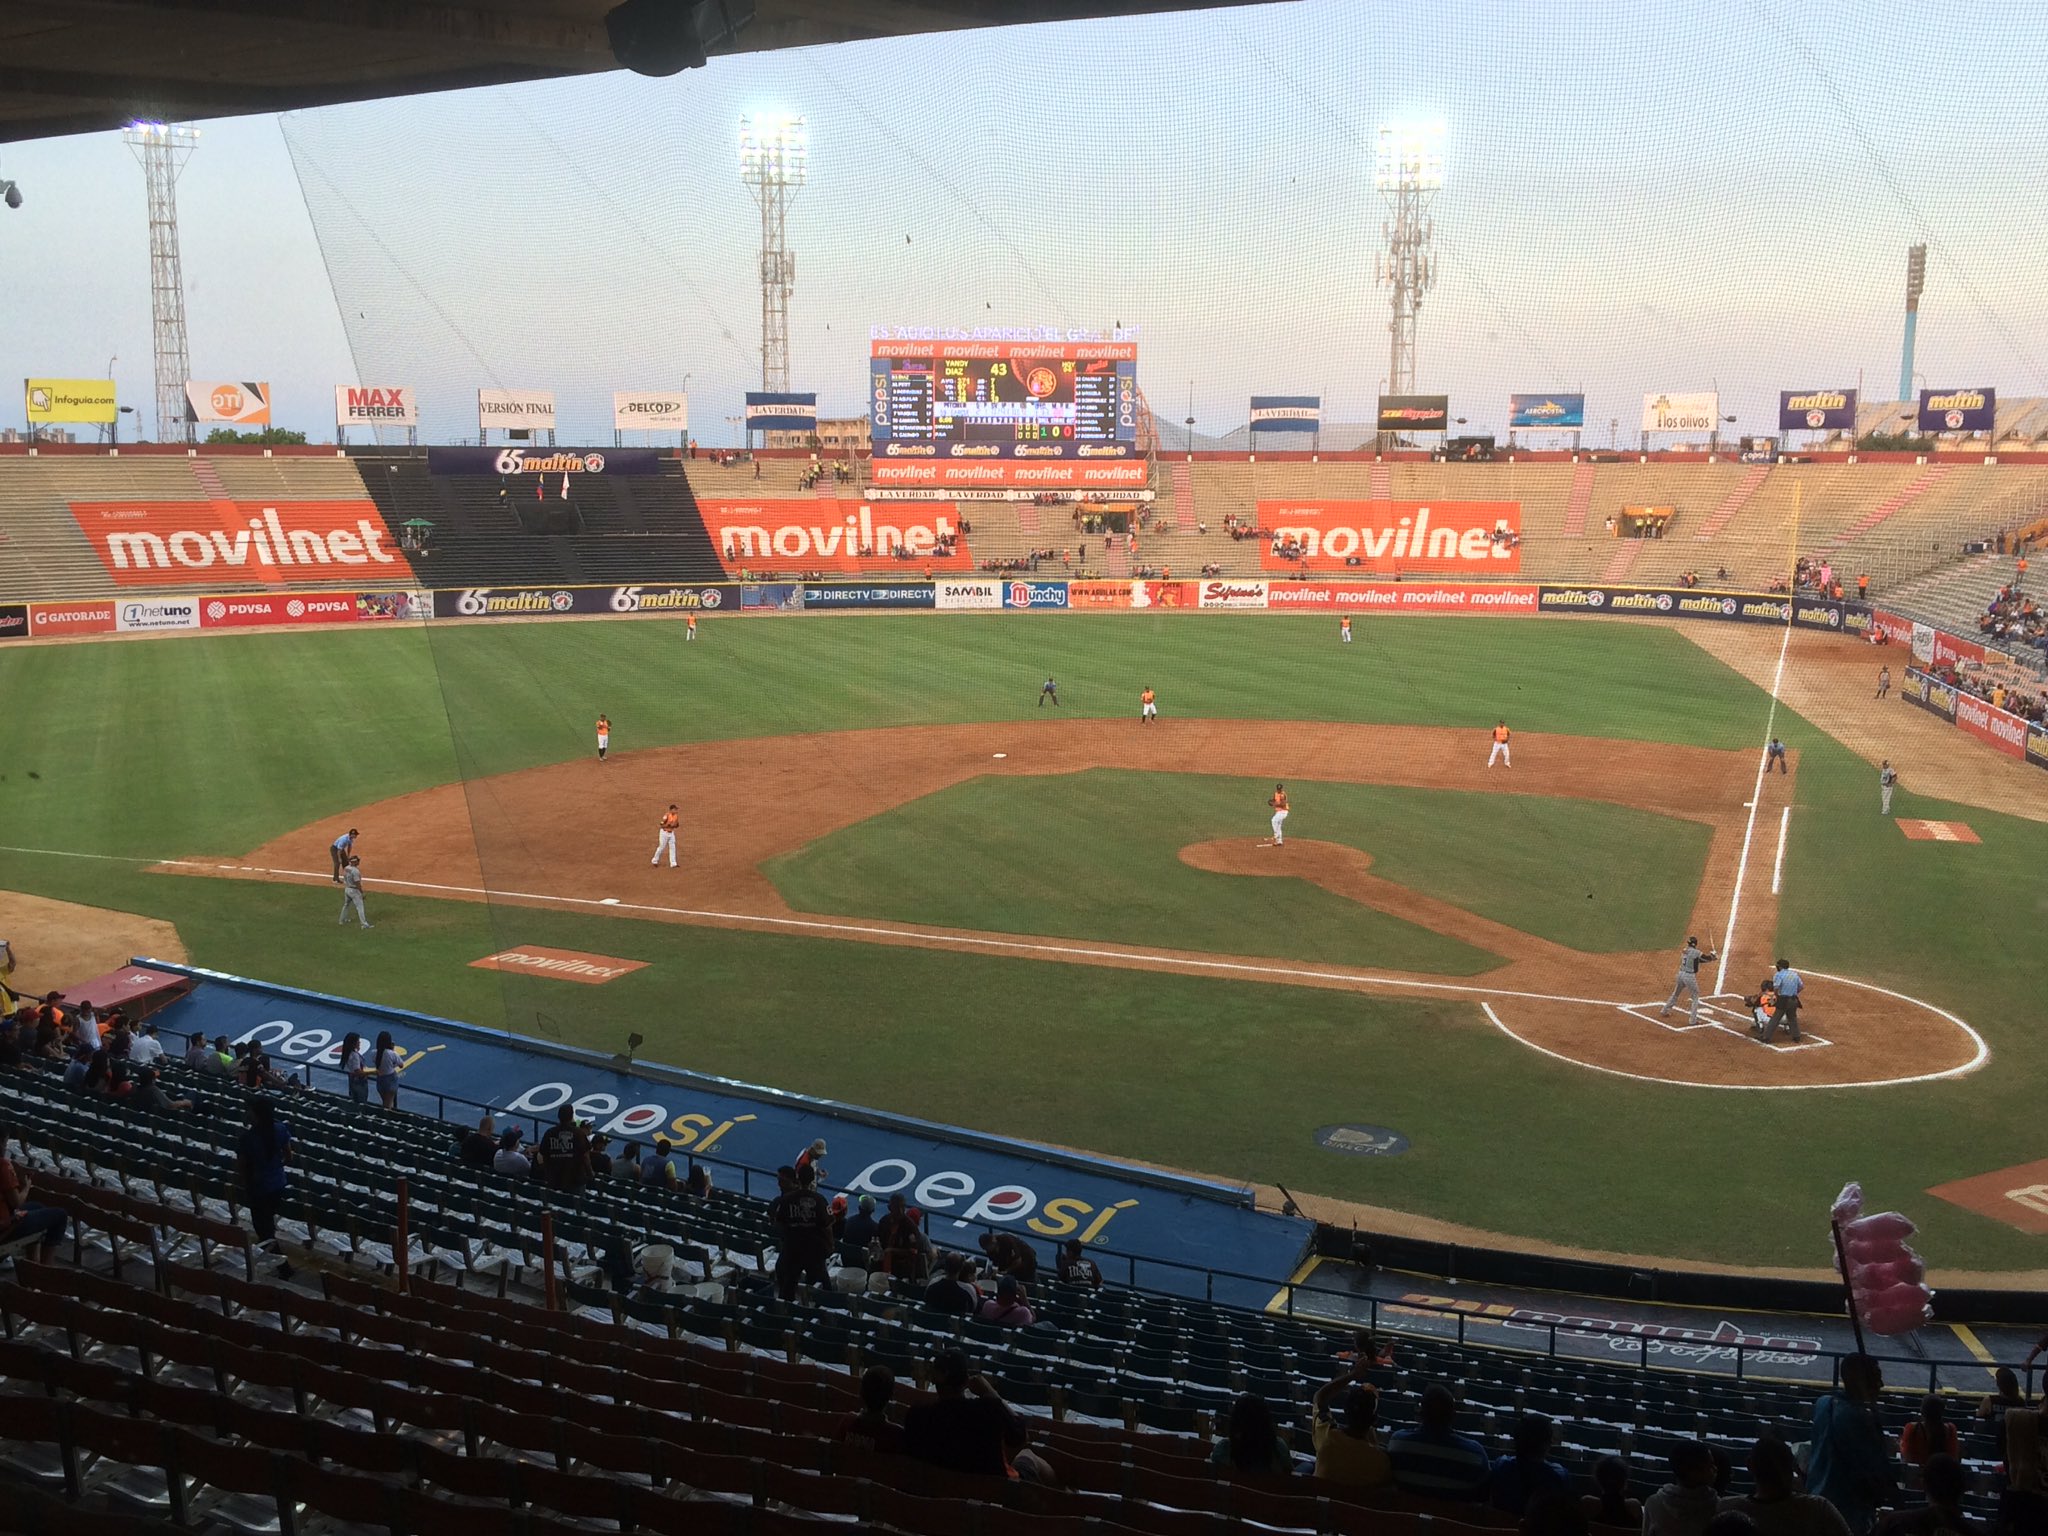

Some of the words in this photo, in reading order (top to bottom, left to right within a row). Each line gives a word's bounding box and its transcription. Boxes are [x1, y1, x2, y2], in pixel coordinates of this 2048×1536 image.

[878, 343, 934, 356] movilnet
[943, 344, 999, 357] movilnet
[1009, 345, 1065, 358] movilnet
[1076, 346, 1131, 358] movilnet
[990, 363, 1007, 376] 43
[54, 395, 114, 406] Infoguia.com
[348, 388, 403, 406] MAX
[349, 407, 405, 417] FERRER
[481, 401, 524, 414] VERSIÓN
[526, 403, 554, 414] FINAL
[628, 402, 672, 413] DELCOP
[1663, 416, 1677, 428] los
[1680, 416, 1709, 428] olivos
[1040, 427, 1047, 437] 1
[1052, 426, 1060, 437] 0
[1063, 426, 1071, 437] 0
[886, 443, 900, 456] 65
[951, 443, 965, 456] 65
[1014, 444, 1028, 456] 65
[1078, 444, 1092, 456] 65
[496, 449, 525, 474] 65
[877, 465, 936, 478] movilnet
[945, 466, 1004, 479] movilnet
[1015, 467, 1073, 479] movilnet
[1085, 466, 1142, 480] movilnet
[105, 508, 394, 568] movilnet
[719, 506, 957, 558] movilnet
[1271, 508, 1513, 558] movilnet
[824, 590, 870, 600] DIRECTV
[890, 590, 935, 599] DIRECTV
[945, 586, 992, 597] SAMBIL
[1006, 582, 1065, 607] Munchy
[1270, 588, 1331, 602] movilnet
[1335, 589, 1397, 603] movilnet
[1403, 591, 1465, 604] movilnet
[1470, 592, 1534, 605] movilnet
[456, 589, 491, 614] 65
[609, 586, 646, 612] 65
[144, 606, 191, 618] netuno
[229, 603, 272, 615] PDVSA
[308, 601, 350, 612] PDVSA
[48, 611, 110, 623] GATORADE
[129, 619, 190, 628] www.netuno.net
[490, 952, 630, 977] movilnet
